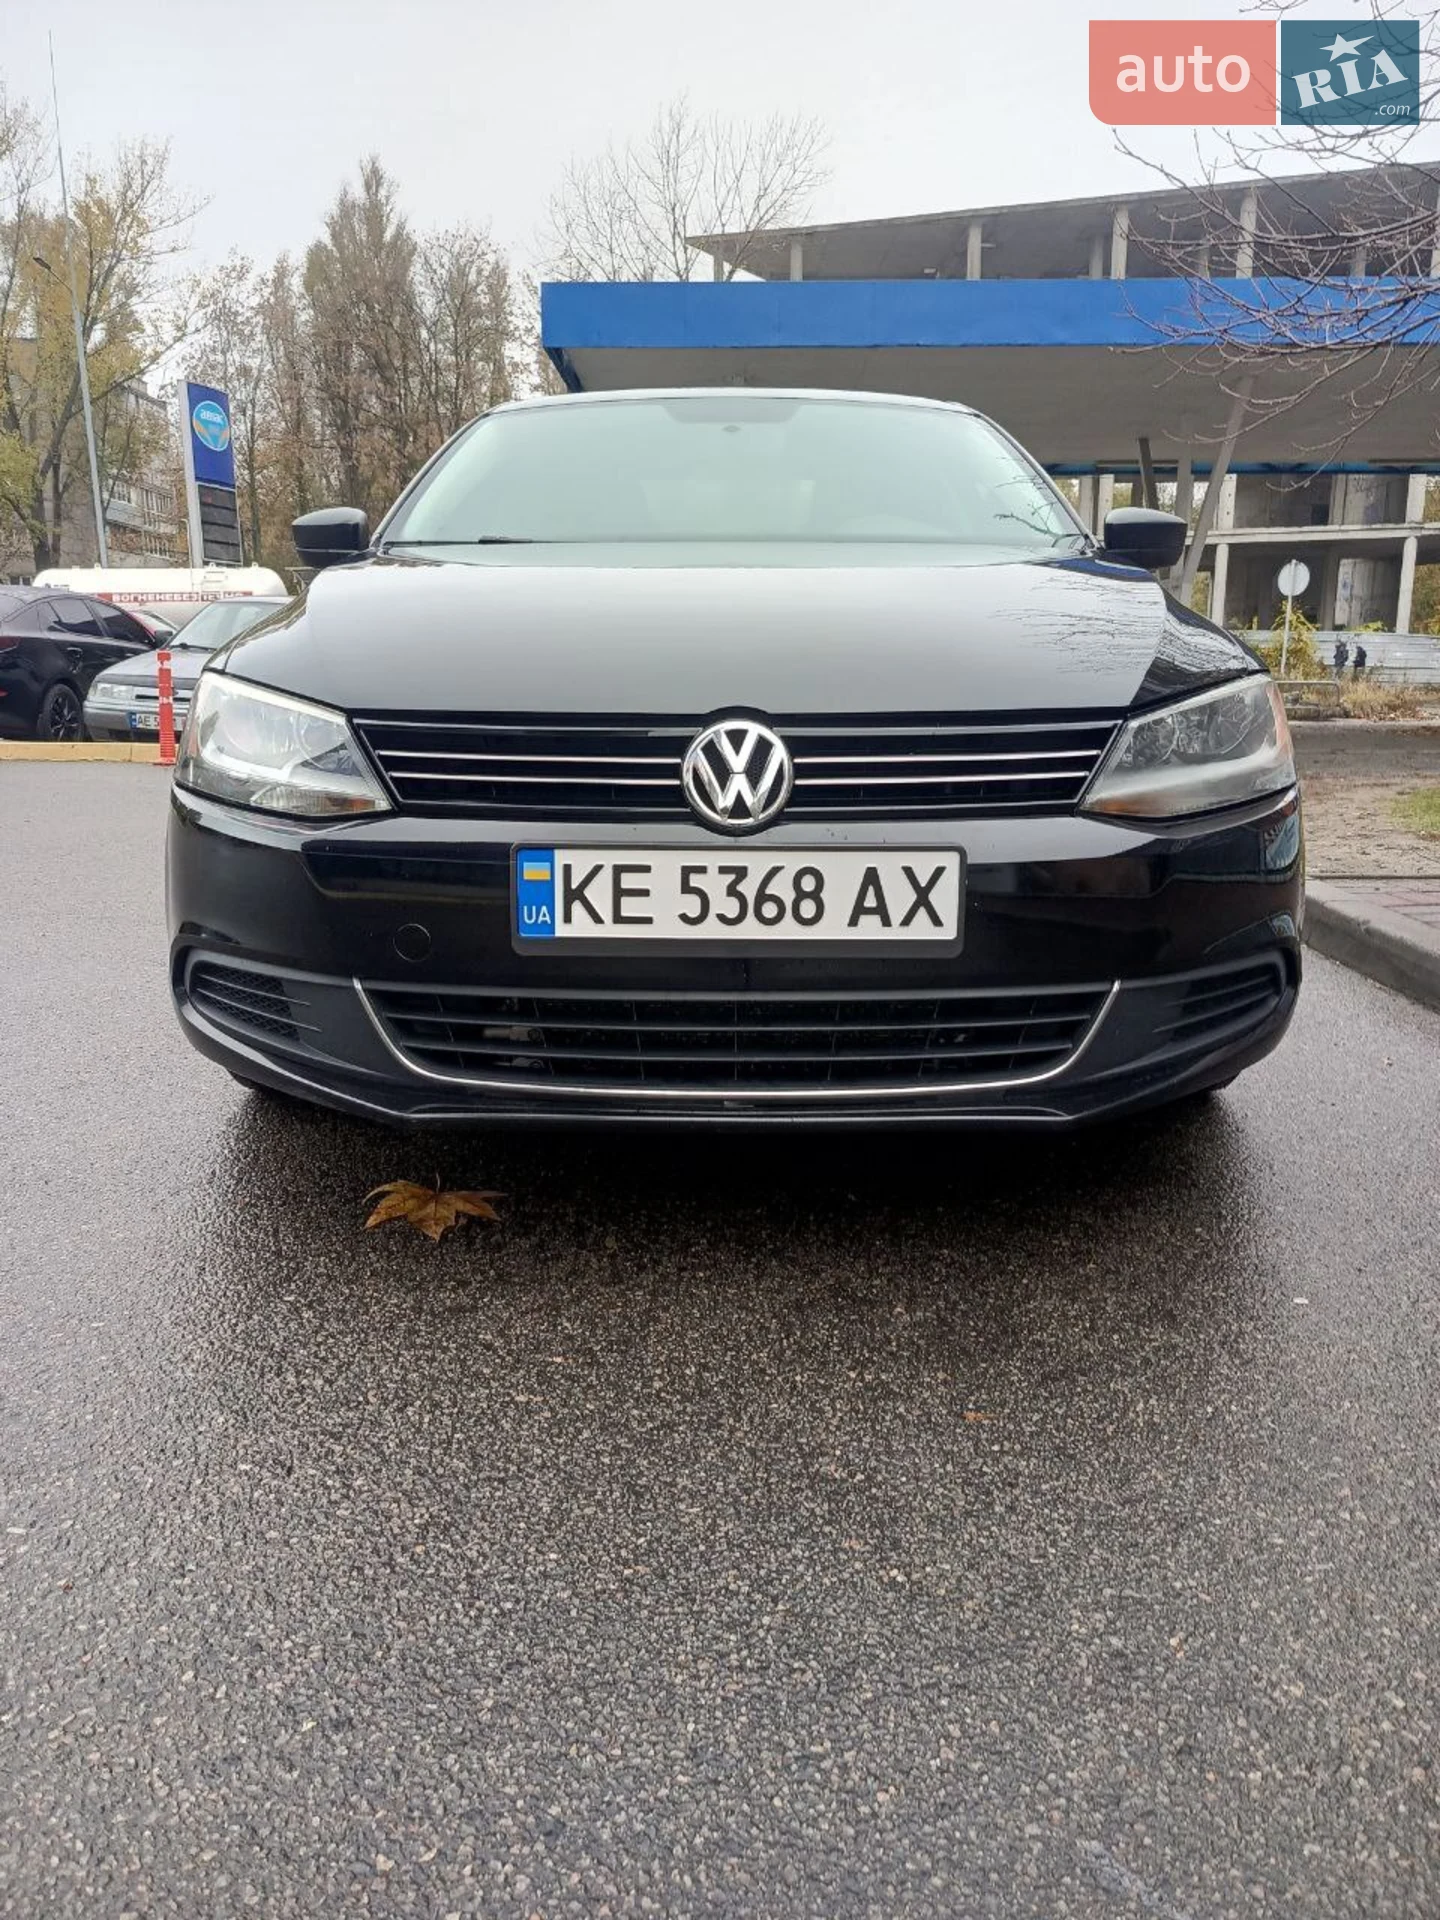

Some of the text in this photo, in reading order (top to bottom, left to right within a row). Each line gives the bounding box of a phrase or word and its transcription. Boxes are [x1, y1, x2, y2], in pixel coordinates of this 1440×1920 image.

[523, 905, 551, 925] UA
[561, 863, 947, 928] KE 5368 AX
